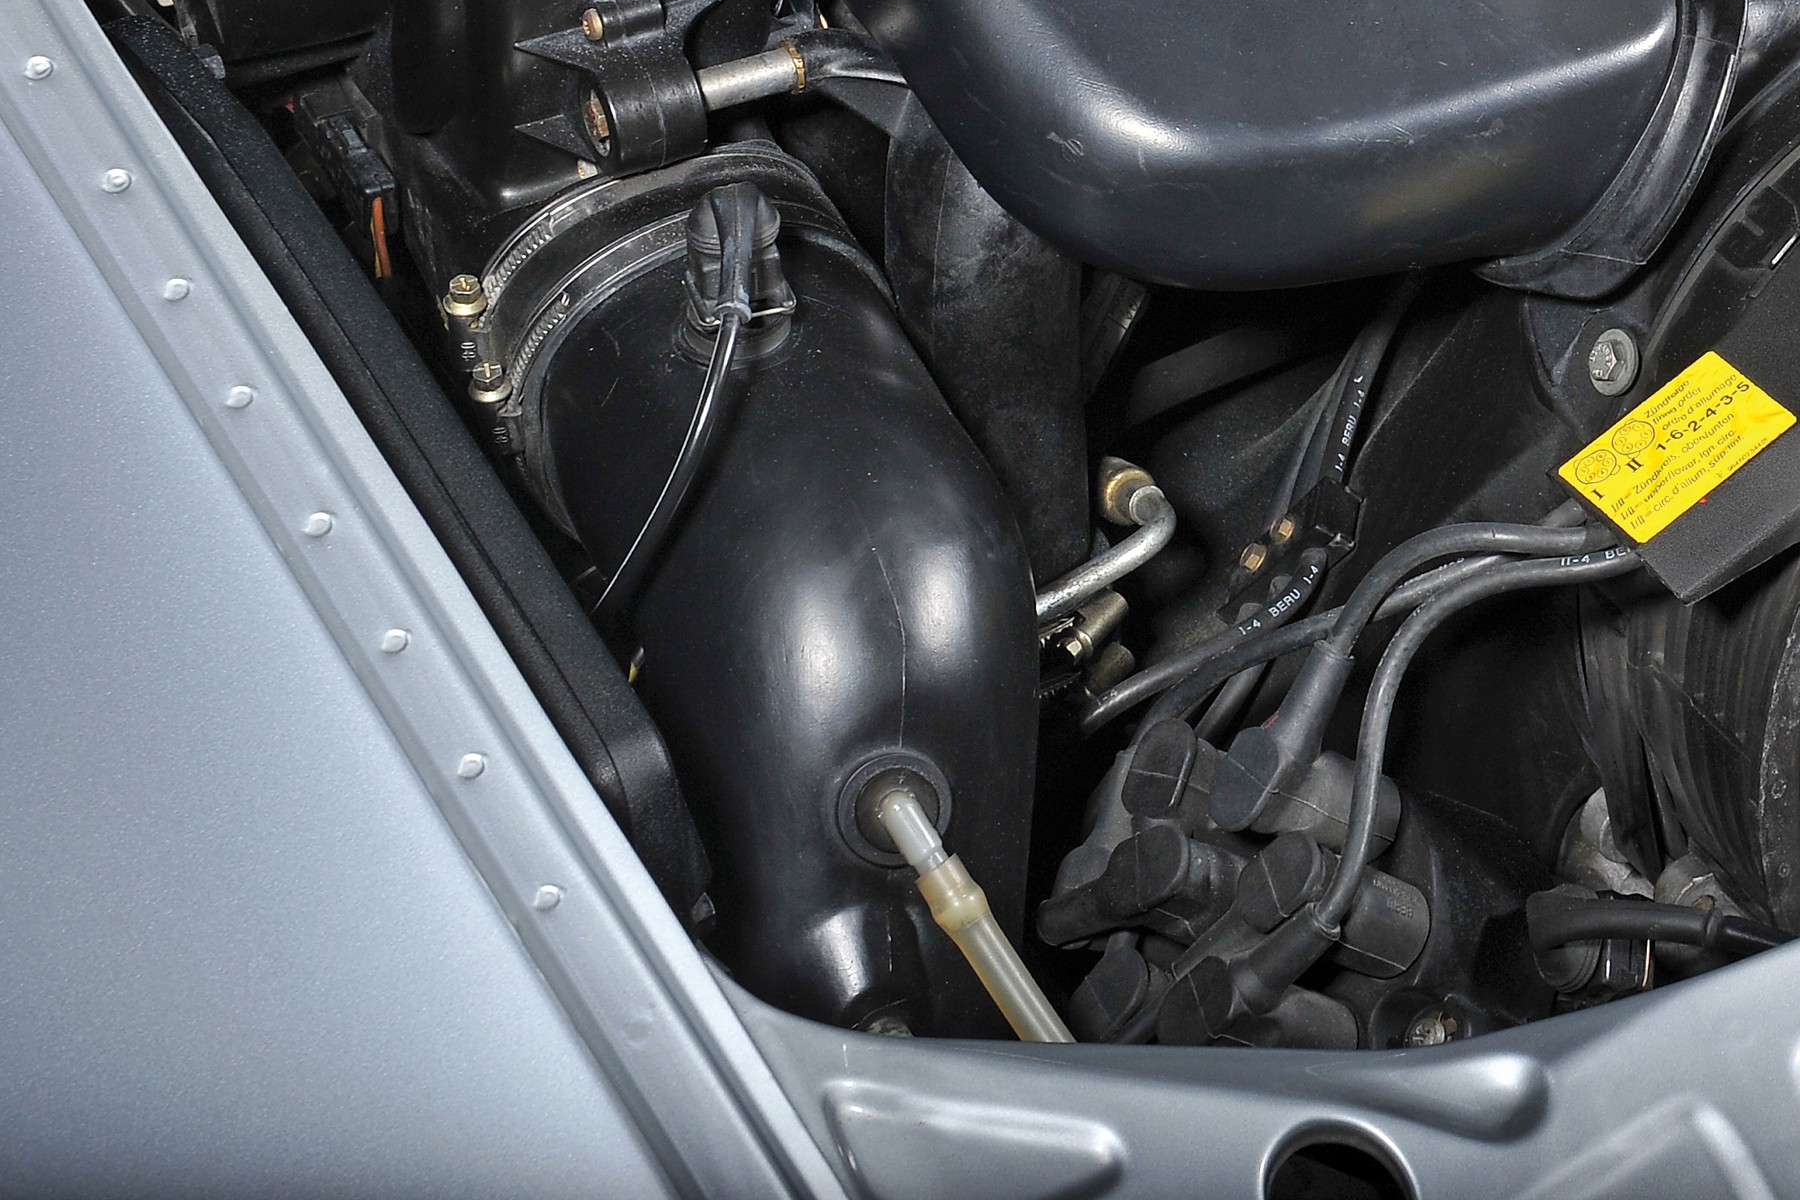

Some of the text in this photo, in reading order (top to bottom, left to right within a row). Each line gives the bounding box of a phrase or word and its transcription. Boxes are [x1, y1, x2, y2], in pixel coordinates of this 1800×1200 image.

[1644, 380, 1689, 418] Zündfolge
[1661, 374, 1736, 431] ordre d'allumage
[1677, 386, 1701, 407] order
[1342, 417, 1358, 446] BERU
[1656, 381, 1749, 450] 1-6-2-4-3-5
[1681, 413, 1734, 453] oben/unten
[1604, 545, 1632, 560] BE
[1268, 588, 1302, 618] BERU
